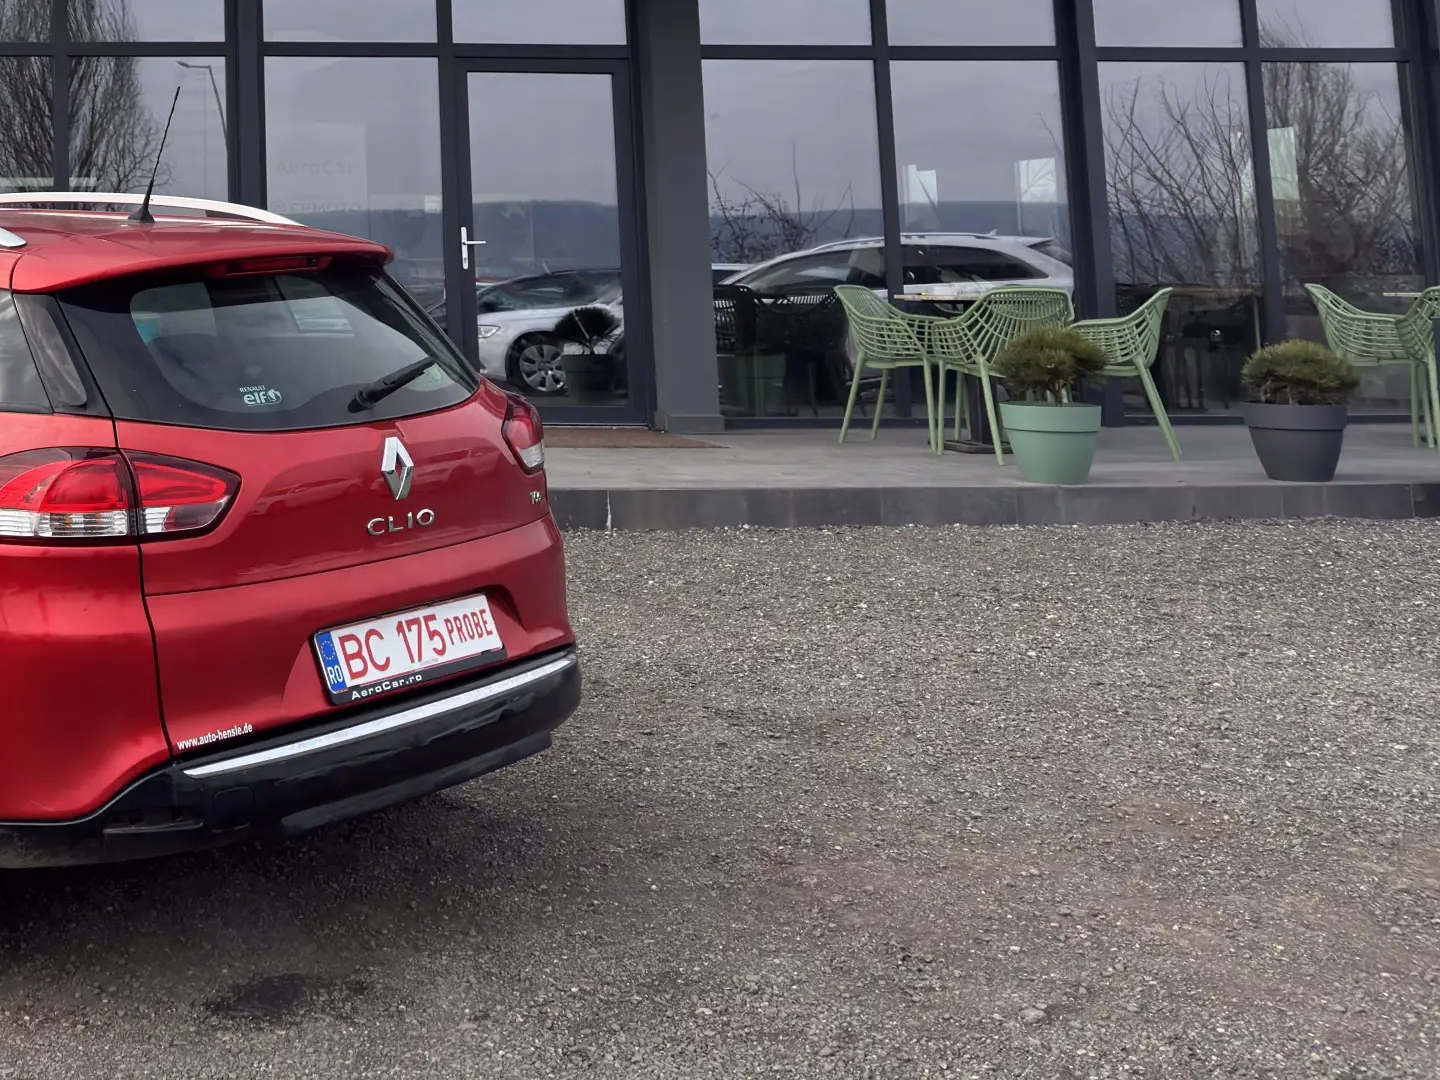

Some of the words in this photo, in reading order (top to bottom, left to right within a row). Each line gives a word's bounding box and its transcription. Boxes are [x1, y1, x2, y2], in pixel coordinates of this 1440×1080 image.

[244, 391, 266, 405] elf
[367, 508, 435, 536] CLIO
[327, 665, 343, 685] RO
[338, 629, 391, 681] BC
[396, 614, 447, 664] 175
[444, 609, 493, 646] PROBE
[351, 674, 423, 701] AeroCar.ro
[177, 723, 253, 750] www.auto-hensle.de
